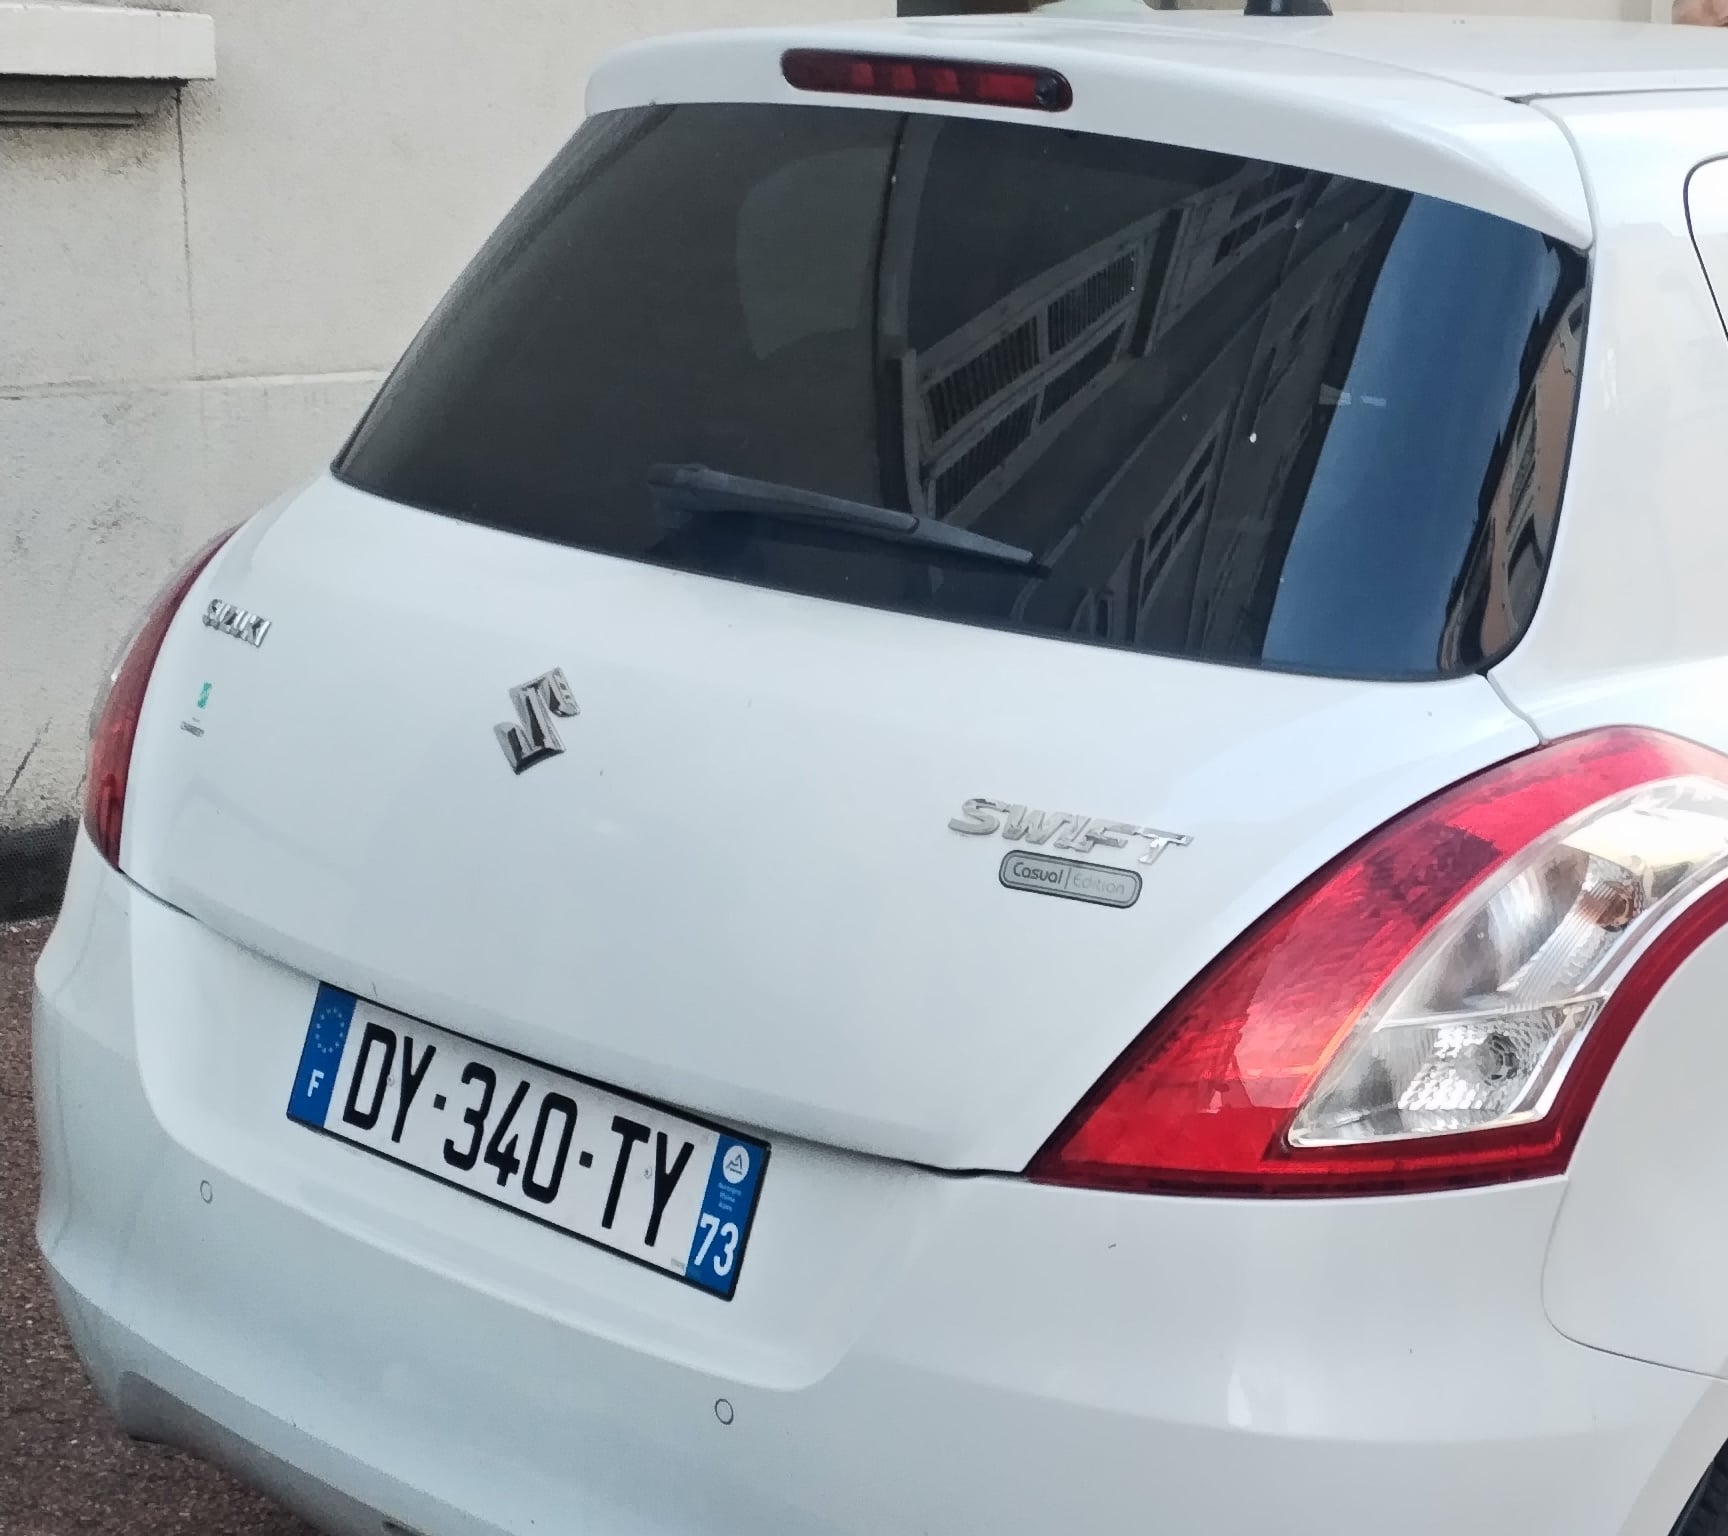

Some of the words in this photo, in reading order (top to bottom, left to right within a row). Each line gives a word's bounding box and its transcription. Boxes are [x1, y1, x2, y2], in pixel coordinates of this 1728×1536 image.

[947, 799, 1194, 866] SWIFT
[1013, 861, 1064, 885] Casual
[1073, 872, 1125, 896] Edition
[306, 1069, 325, 1097] F
[343, 1022, 694, 1247] DY-340-TY
[693, 1213, 740, 1277] 73
